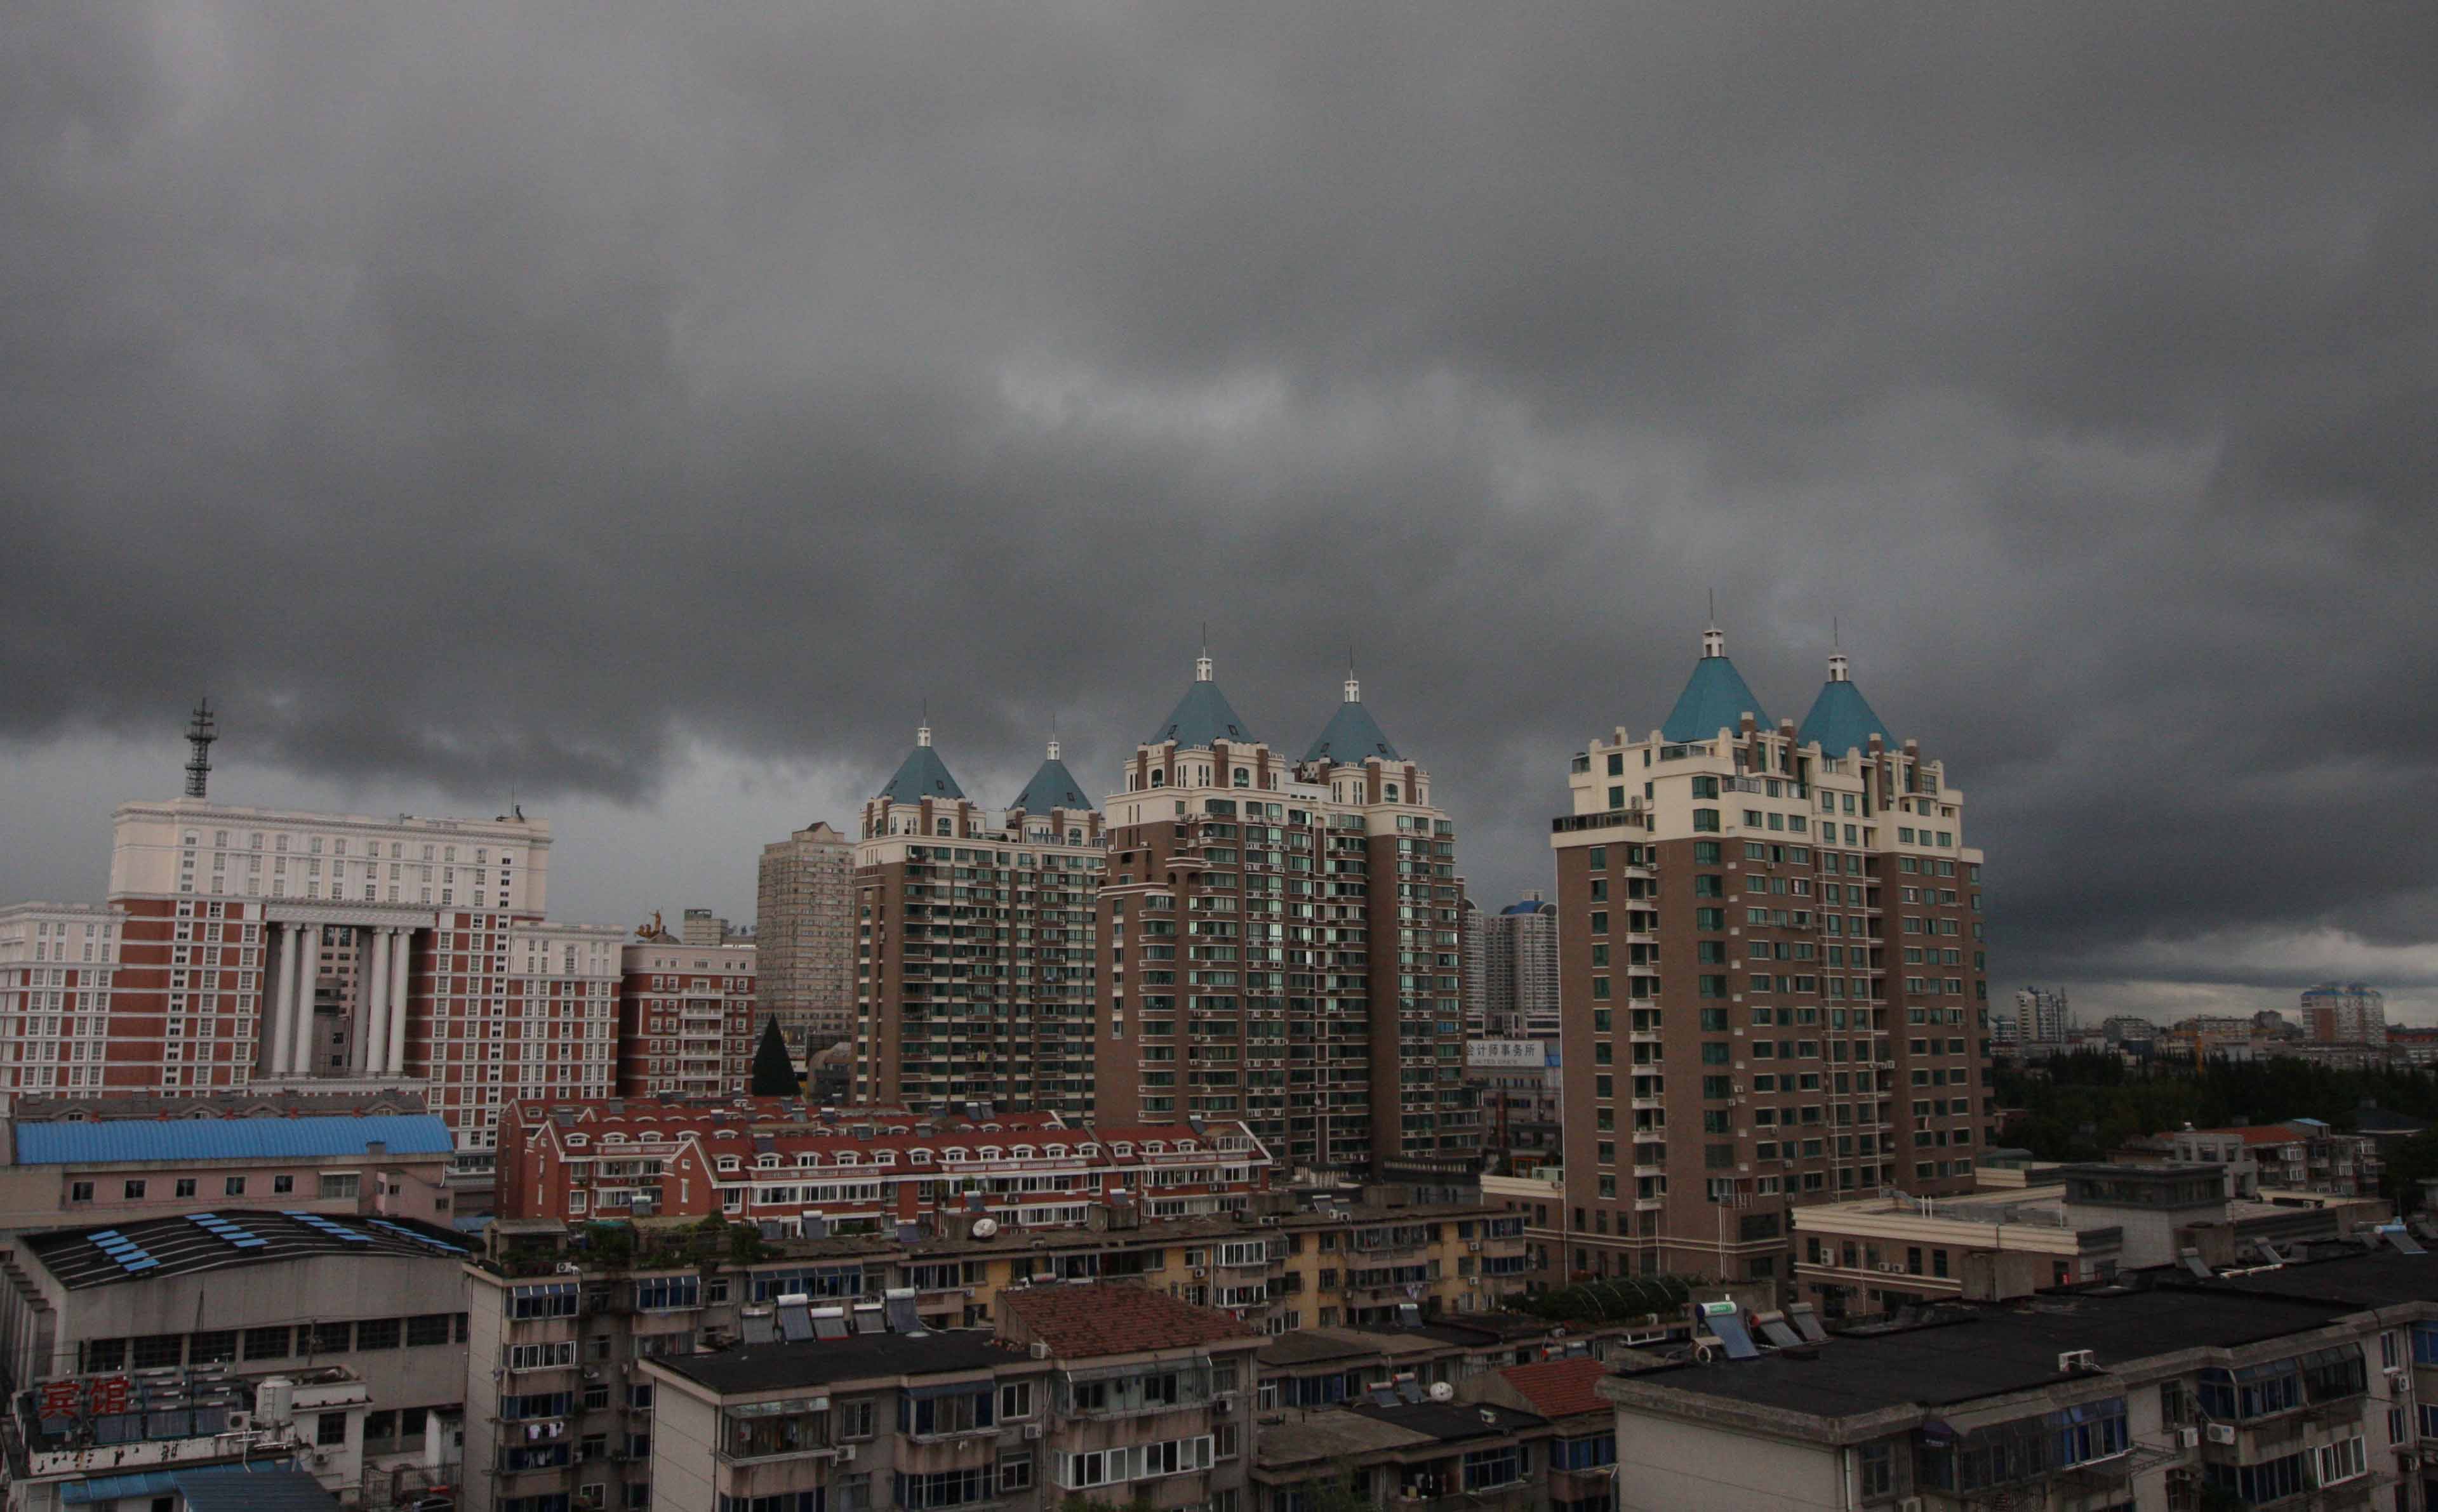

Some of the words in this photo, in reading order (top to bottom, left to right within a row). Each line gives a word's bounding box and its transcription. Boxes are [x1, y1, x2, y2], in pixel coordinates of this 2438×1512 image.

[1467, 1044, 1535, 1056] 会计师事务所
[39, 1376, 131, 1421] 宾馆
